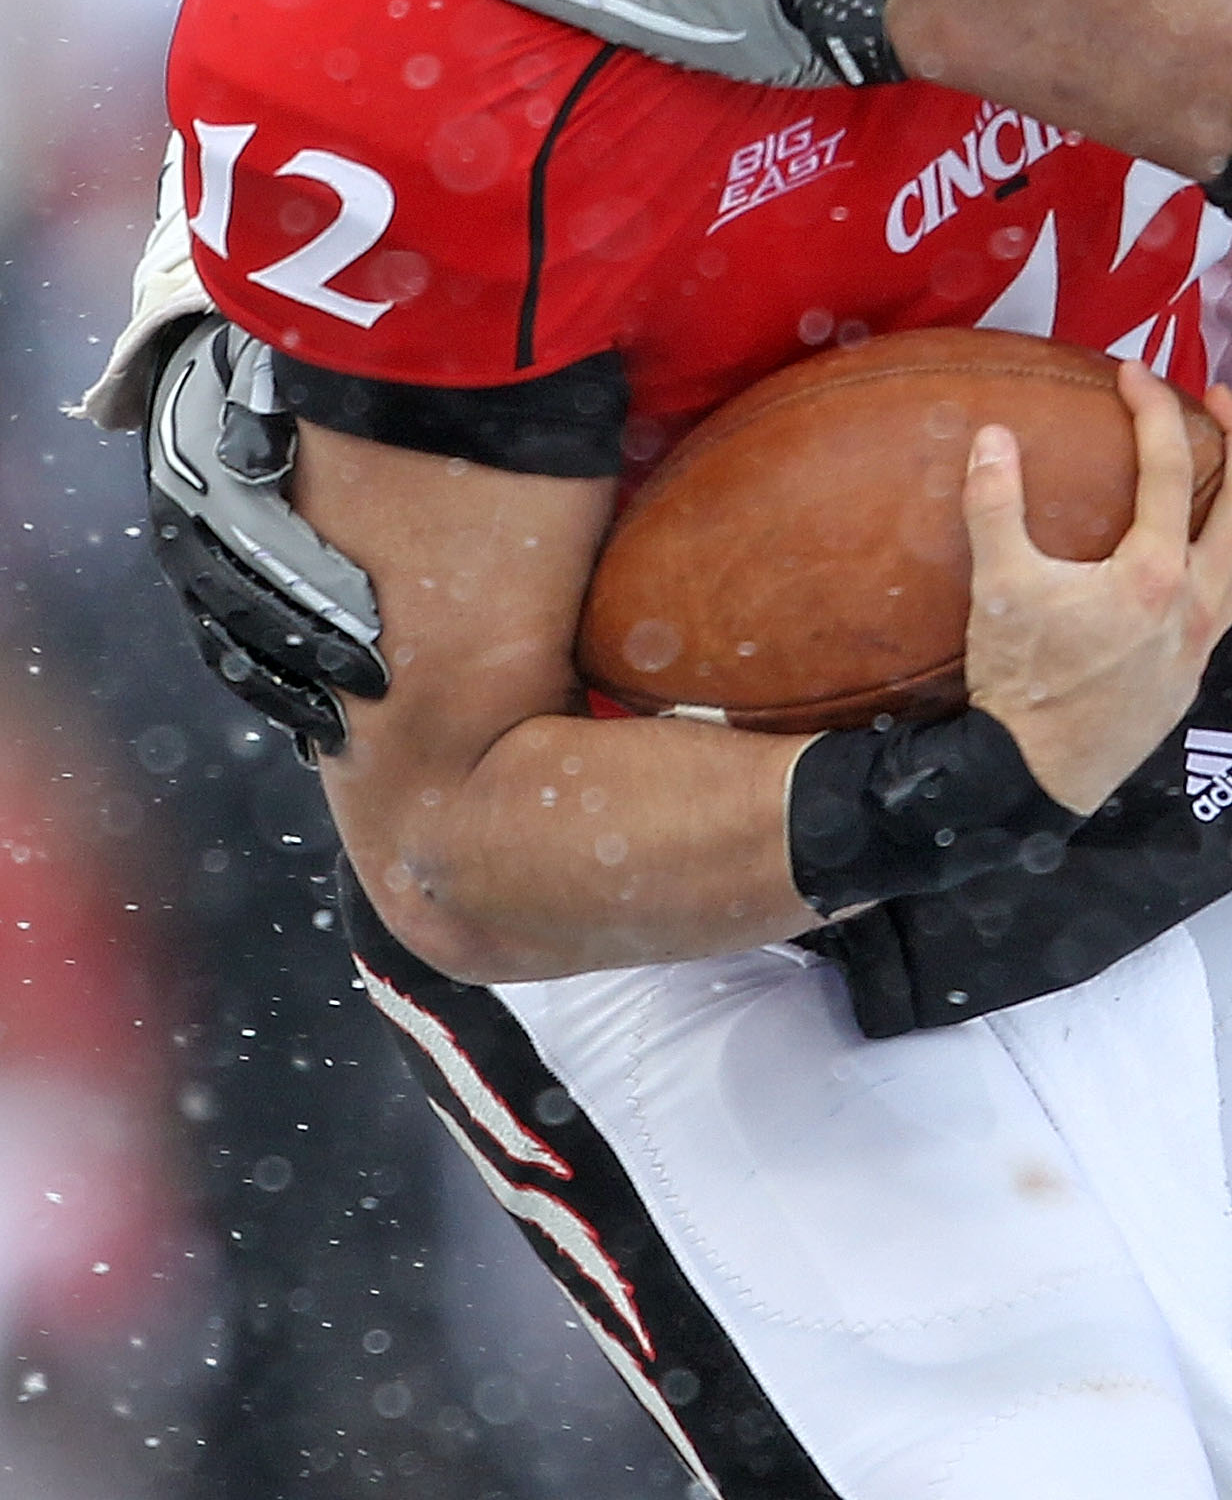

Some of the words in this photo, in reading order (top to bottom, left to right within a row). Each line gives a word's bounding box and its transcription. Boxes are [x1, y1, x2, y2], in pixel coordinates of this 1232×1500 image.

[717, 127, 848, 215] EAST
[728, 115, 815, 183] BIG
[884, 106, 1065, 255] CINCI
[188, 117, 396, 330] 12
